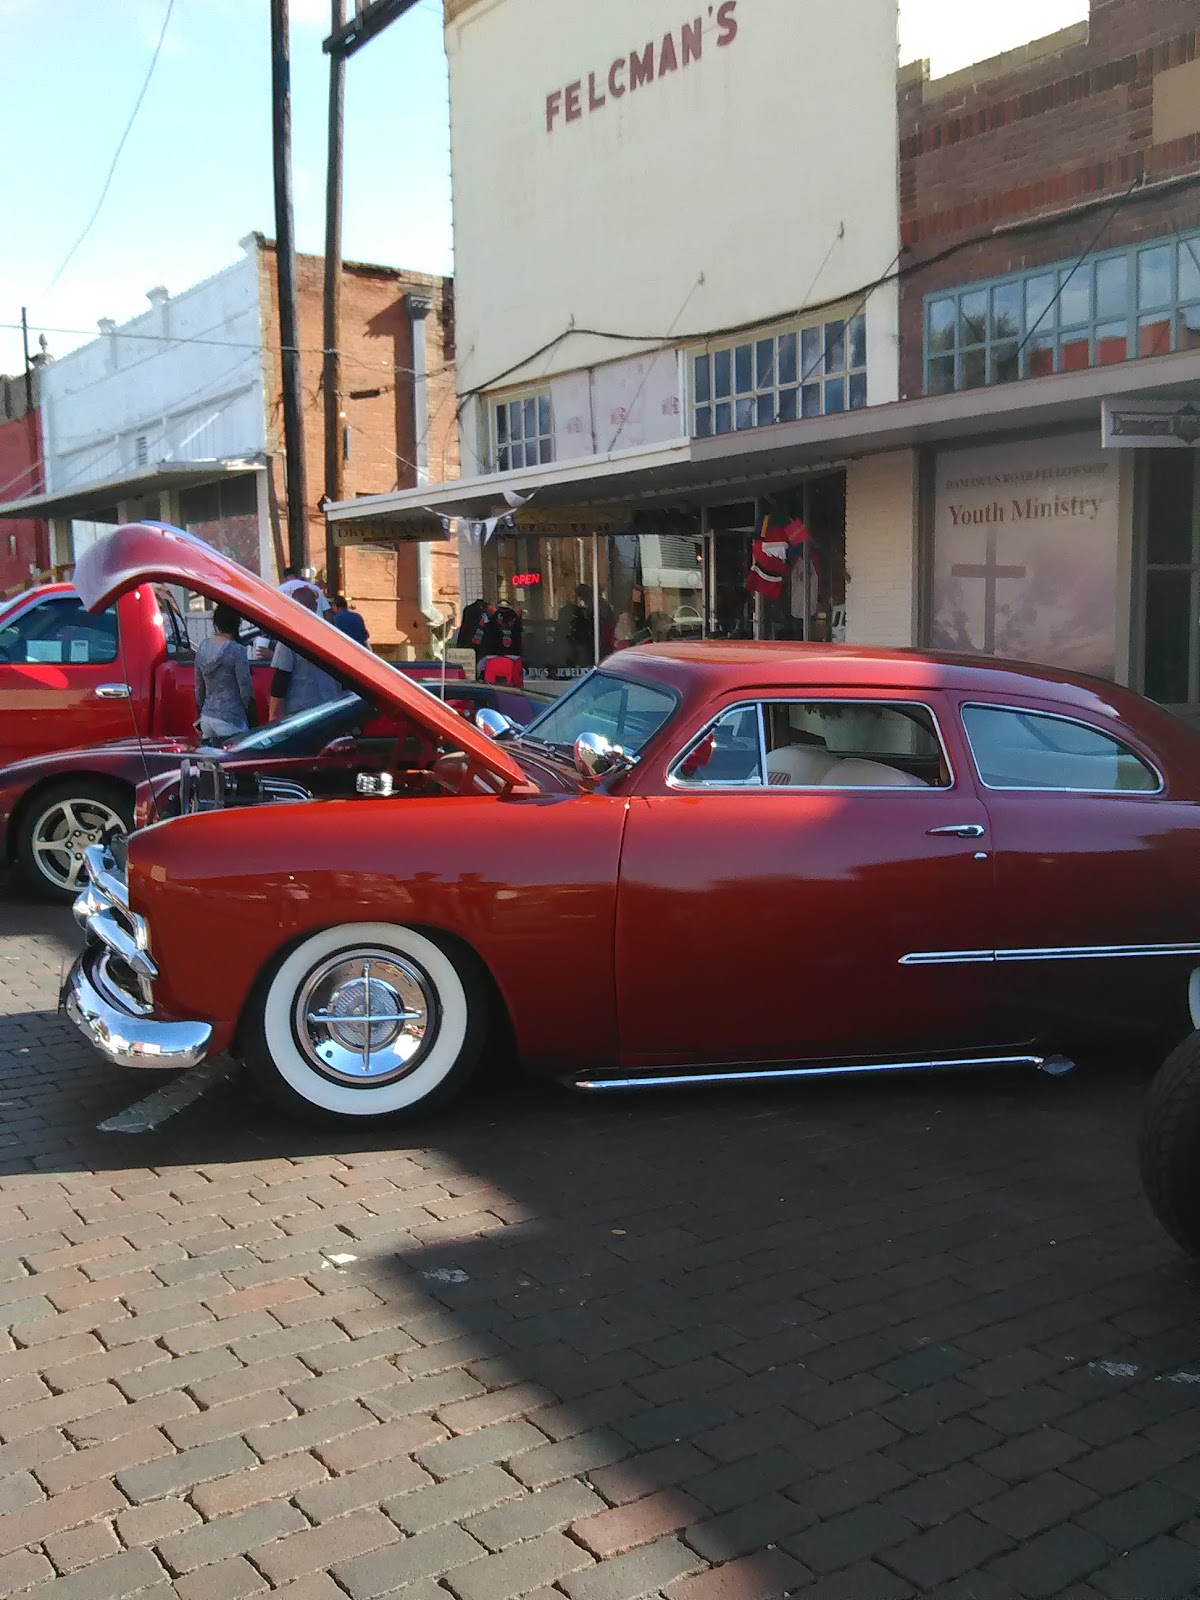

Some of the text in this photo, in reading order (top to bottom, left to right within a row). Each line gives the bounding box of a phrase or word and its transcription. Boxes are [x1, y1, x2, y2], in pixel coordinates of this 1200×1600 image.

[546, 1, 738, 133] FELCMAN'S
[949, 495, 1101, 526] Youth Ministry
[511, 573, 541, 586] OPEN
